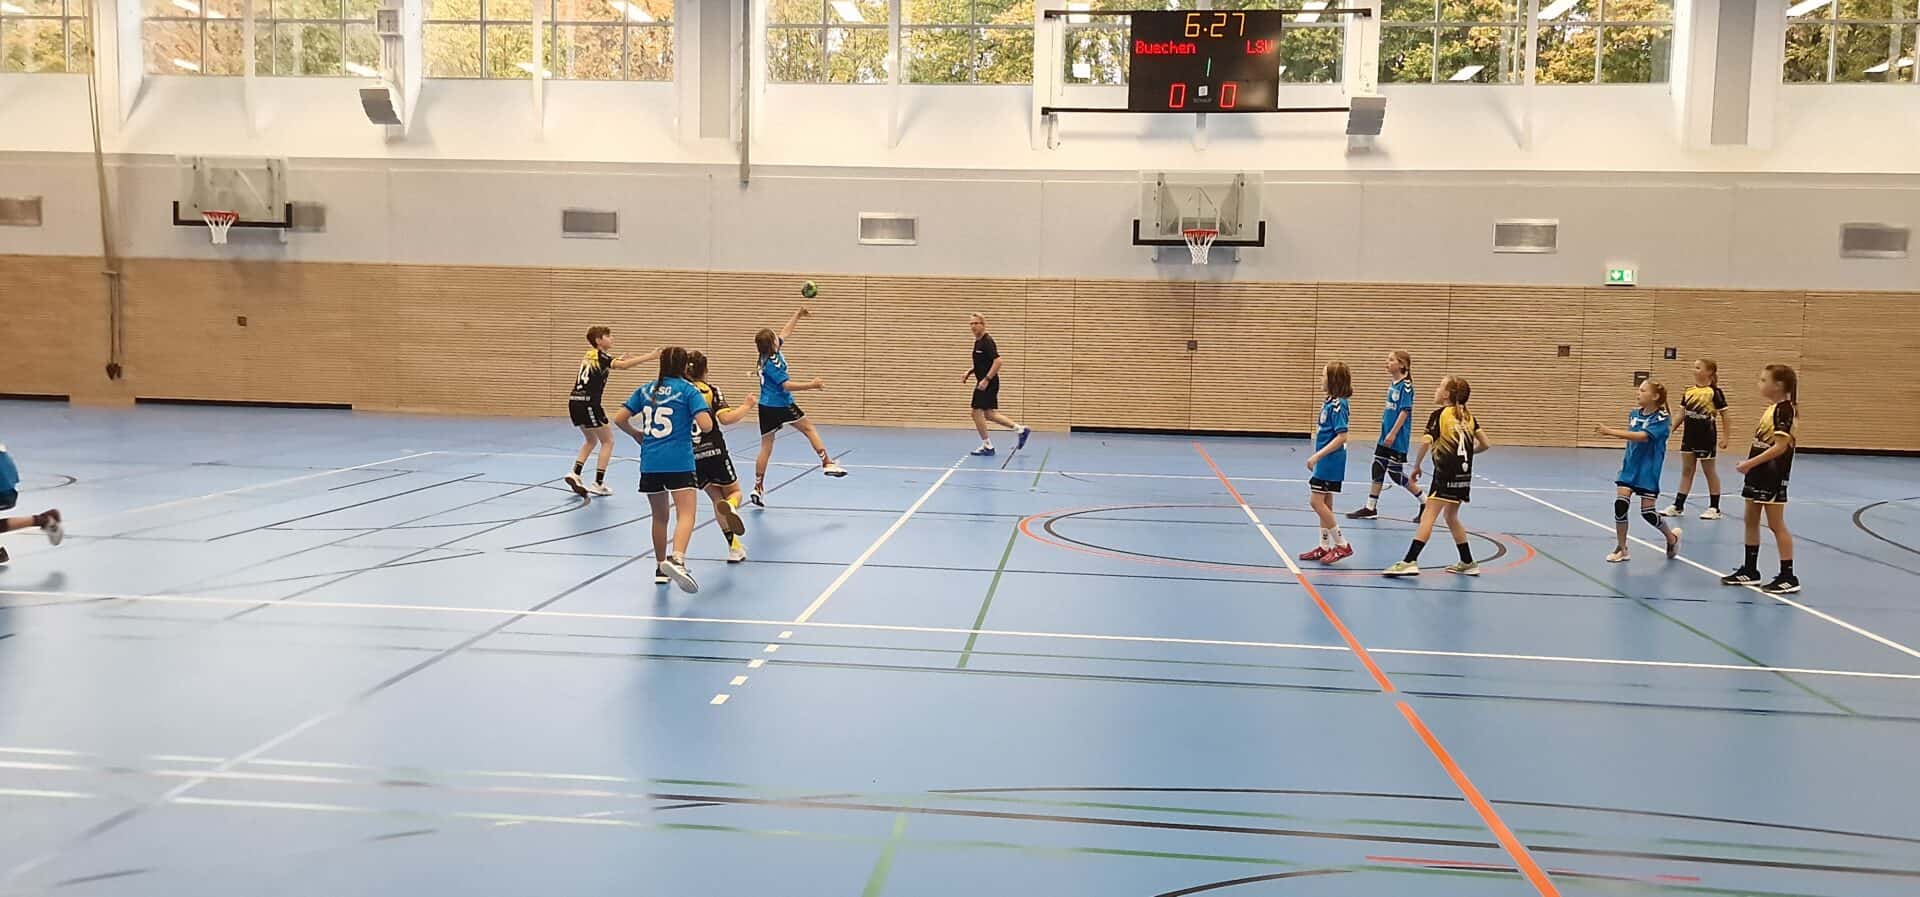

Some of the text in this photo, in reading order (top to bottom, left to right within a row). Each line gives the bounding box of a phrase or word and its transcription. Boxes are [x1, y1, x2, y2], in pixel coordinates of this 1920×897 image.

[1246, 39, 1274, 54] LSV
[1169, 83, 1186, 108] 0
[1220, 83, 1237, 108] 0
[577, 361, 590, 384] 14
[643, 406, 674, 438] 15
[1457, 430, 1468, 461] 4
